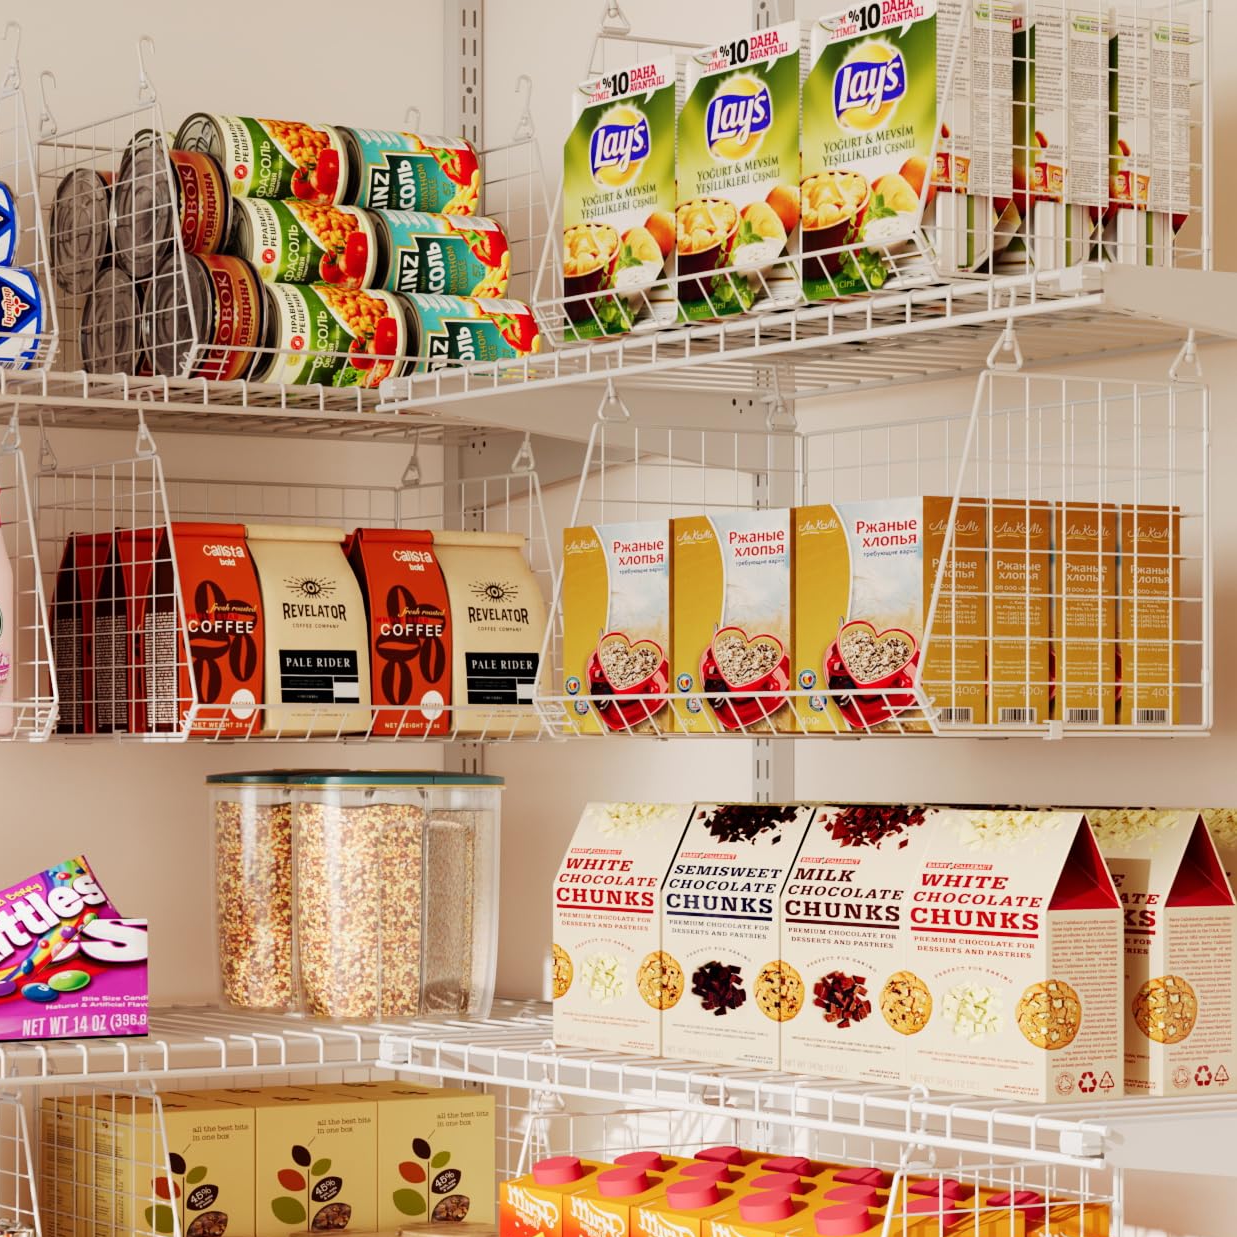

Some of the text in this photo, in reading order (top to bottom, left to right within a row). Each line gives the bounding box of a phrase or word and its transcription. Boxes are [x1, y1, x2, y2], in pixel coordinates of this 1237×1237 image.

[749, 31, 779, 49] DAHA
[629, 64, 656, 81] DAHA
[836, 56, 902, 113] Lay's
[709, 92, 766, 147] Lay's
[591, 123, 645, 173] Lay's
[823, 140, 864, 160] YOĞURT
[257, 141, 270, 198] ФАСОЛЬ
[285, 224, 298, 281] ФАСОЛЬ
[855, 519, 917, 534] Ржаные
[728, 530, 784, 545] Ржаные
[862, 534, 917, 548] хлопья
[613, 541, 664, 554] Ржаные
[734, 544, 784, 557] хлопья
[220, 559, 236, 567] bold
[618, 554, 664, 566] хлопья
[206, 602, 257, 614] fresh roasted
[282, 602, 347, 623] REVELATOR
[468, 606, 529, 625] REVELATOR
[188, 620, 254, 634] COFFEE
[380, 623, 443, 637] COFFEE
[286, 657, 350, 668] PALE RIDER
[471, 660, 533, 670] PALE RIDER
[565, 857, 633, 872] WHITE
[674, 864, 782, 880] SEMISWEET
[559, 873, 658, 888] CHOCOLATE
[794, 868, 855, 882] MILK
[921, 873, 1009, 890] WHITE
[668, 879, 777, 894] CHOCOLATE
[787, 884, 904, 900] CHOCOLATE
[556, 887, 654, 907] CHUNKS
[666, 893, 773, 914] CHUNKS
[913, 891, 1044, 908] CHOCOLATE
[785, 900, 900, 922] CHUNKS
[910, 906, 1039, 931] CHUNKS
[914, 936, 956, 946] PREMIUM
[959, 938, 1014, 948] CHOCOLATE
[917, 945, 1032, 959] DESSERTS AND PASTRIES
[22, 1015, 107, 1037] NET WT 14 OZ
[216, 1132, 230, 1140] box
[315, 1180, 336, 1196] 45%
